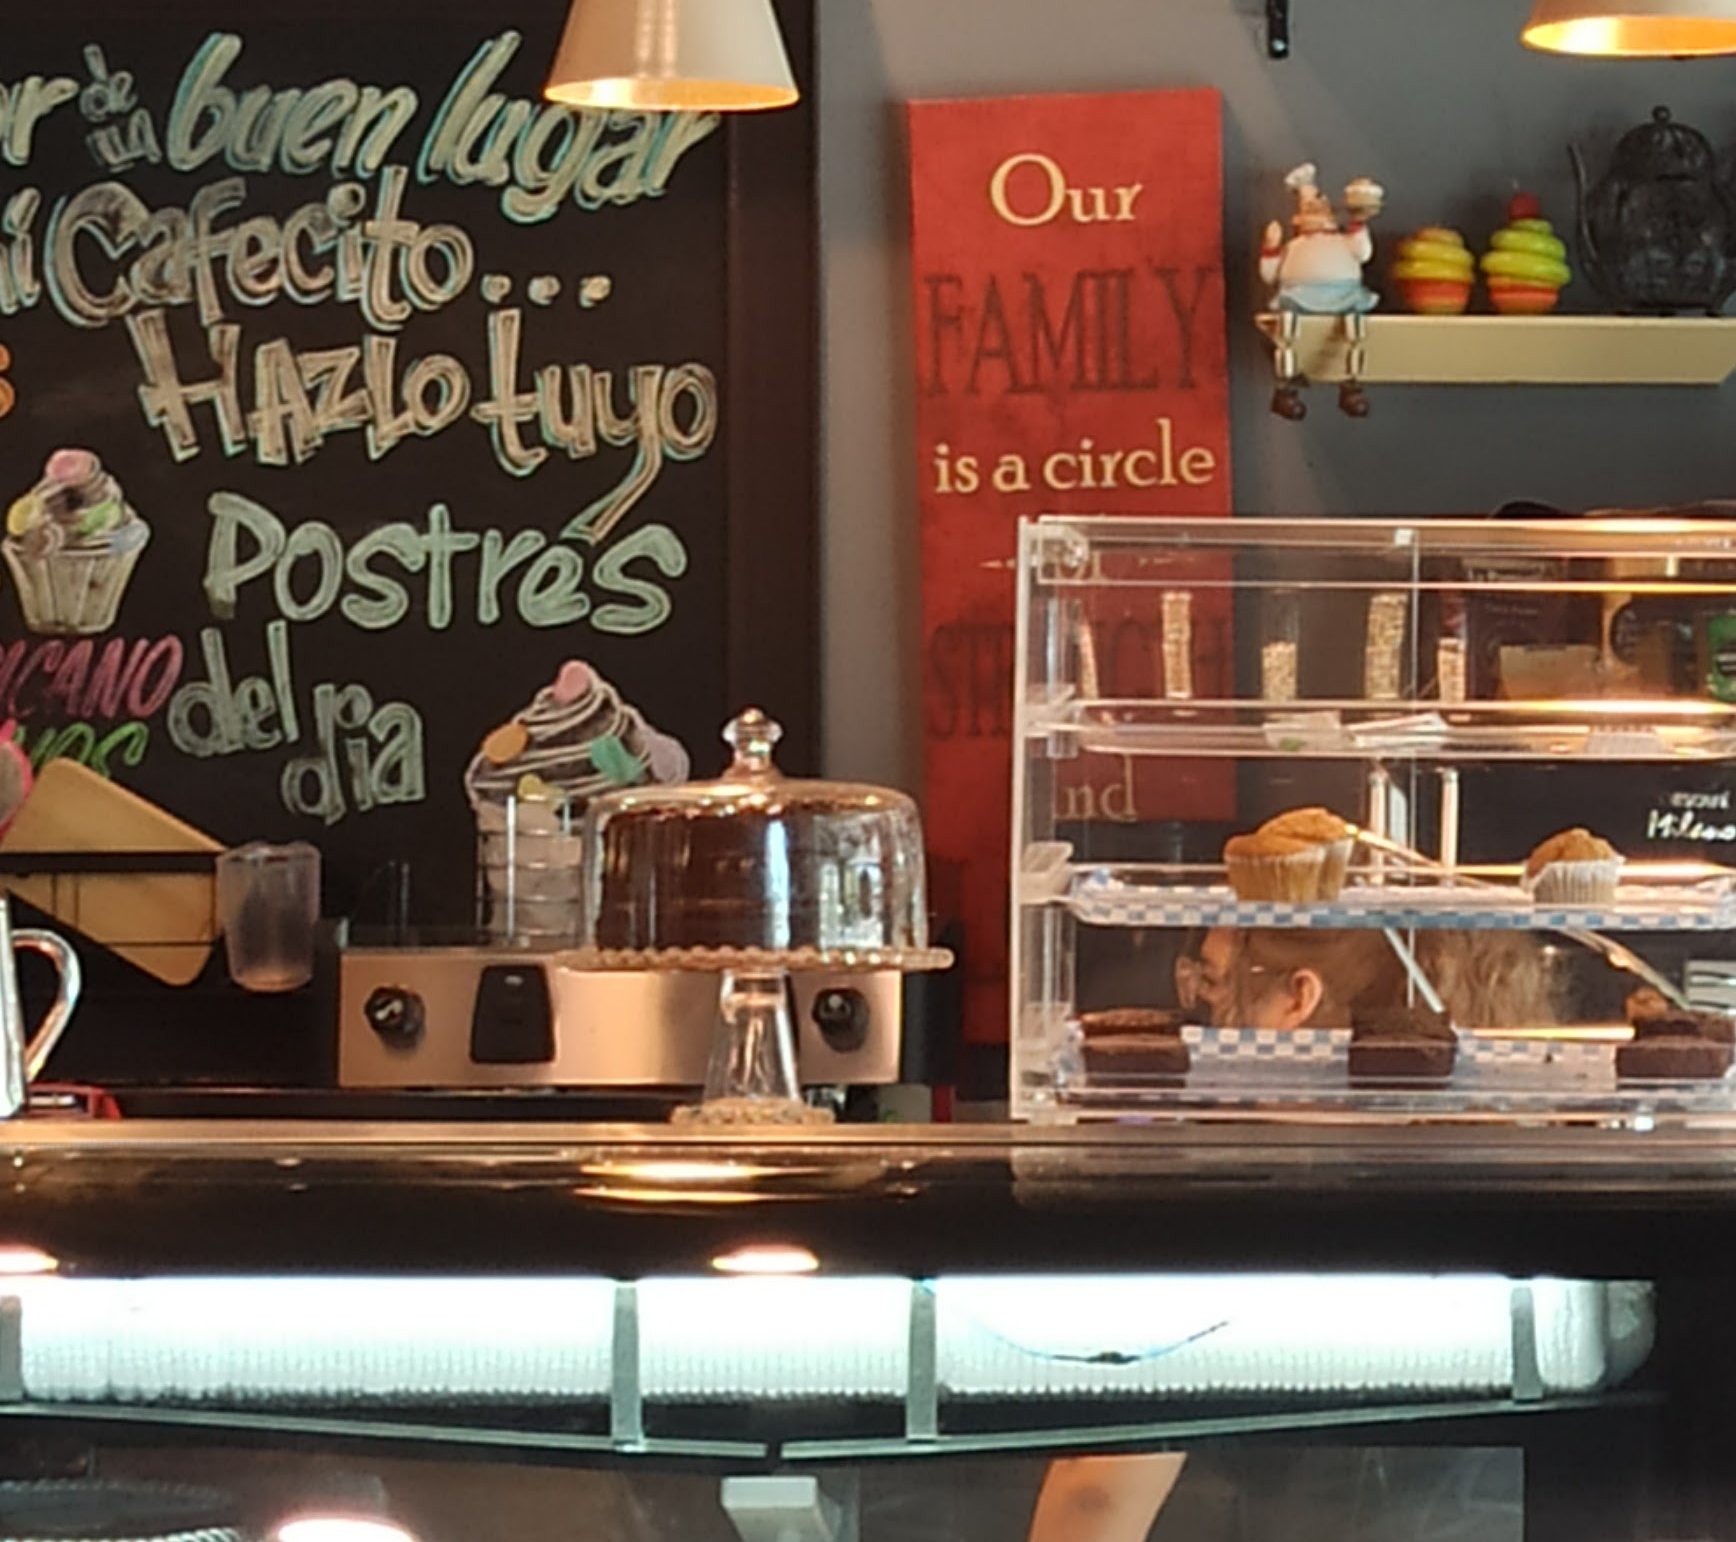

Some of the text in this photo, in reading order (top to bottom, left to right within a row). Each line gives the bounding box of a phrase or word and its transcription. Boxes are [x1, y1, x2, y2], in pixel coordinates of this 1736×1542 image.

[0, 73, 79, 166] r
[166, 31, 419, 180] buen
[416, 29, 722, 224] lugar
[989, 152, 1144, 227] Our
[921, 265, 1217, 396] FAMILY
[934, 415, 1216, 494] is a circle
[204, 491, 688, 635] Postres
[0, 633, 184, 719] ICANO
[166, 620, 299, 756] del
[1052, 752, 1138, 823] nd
